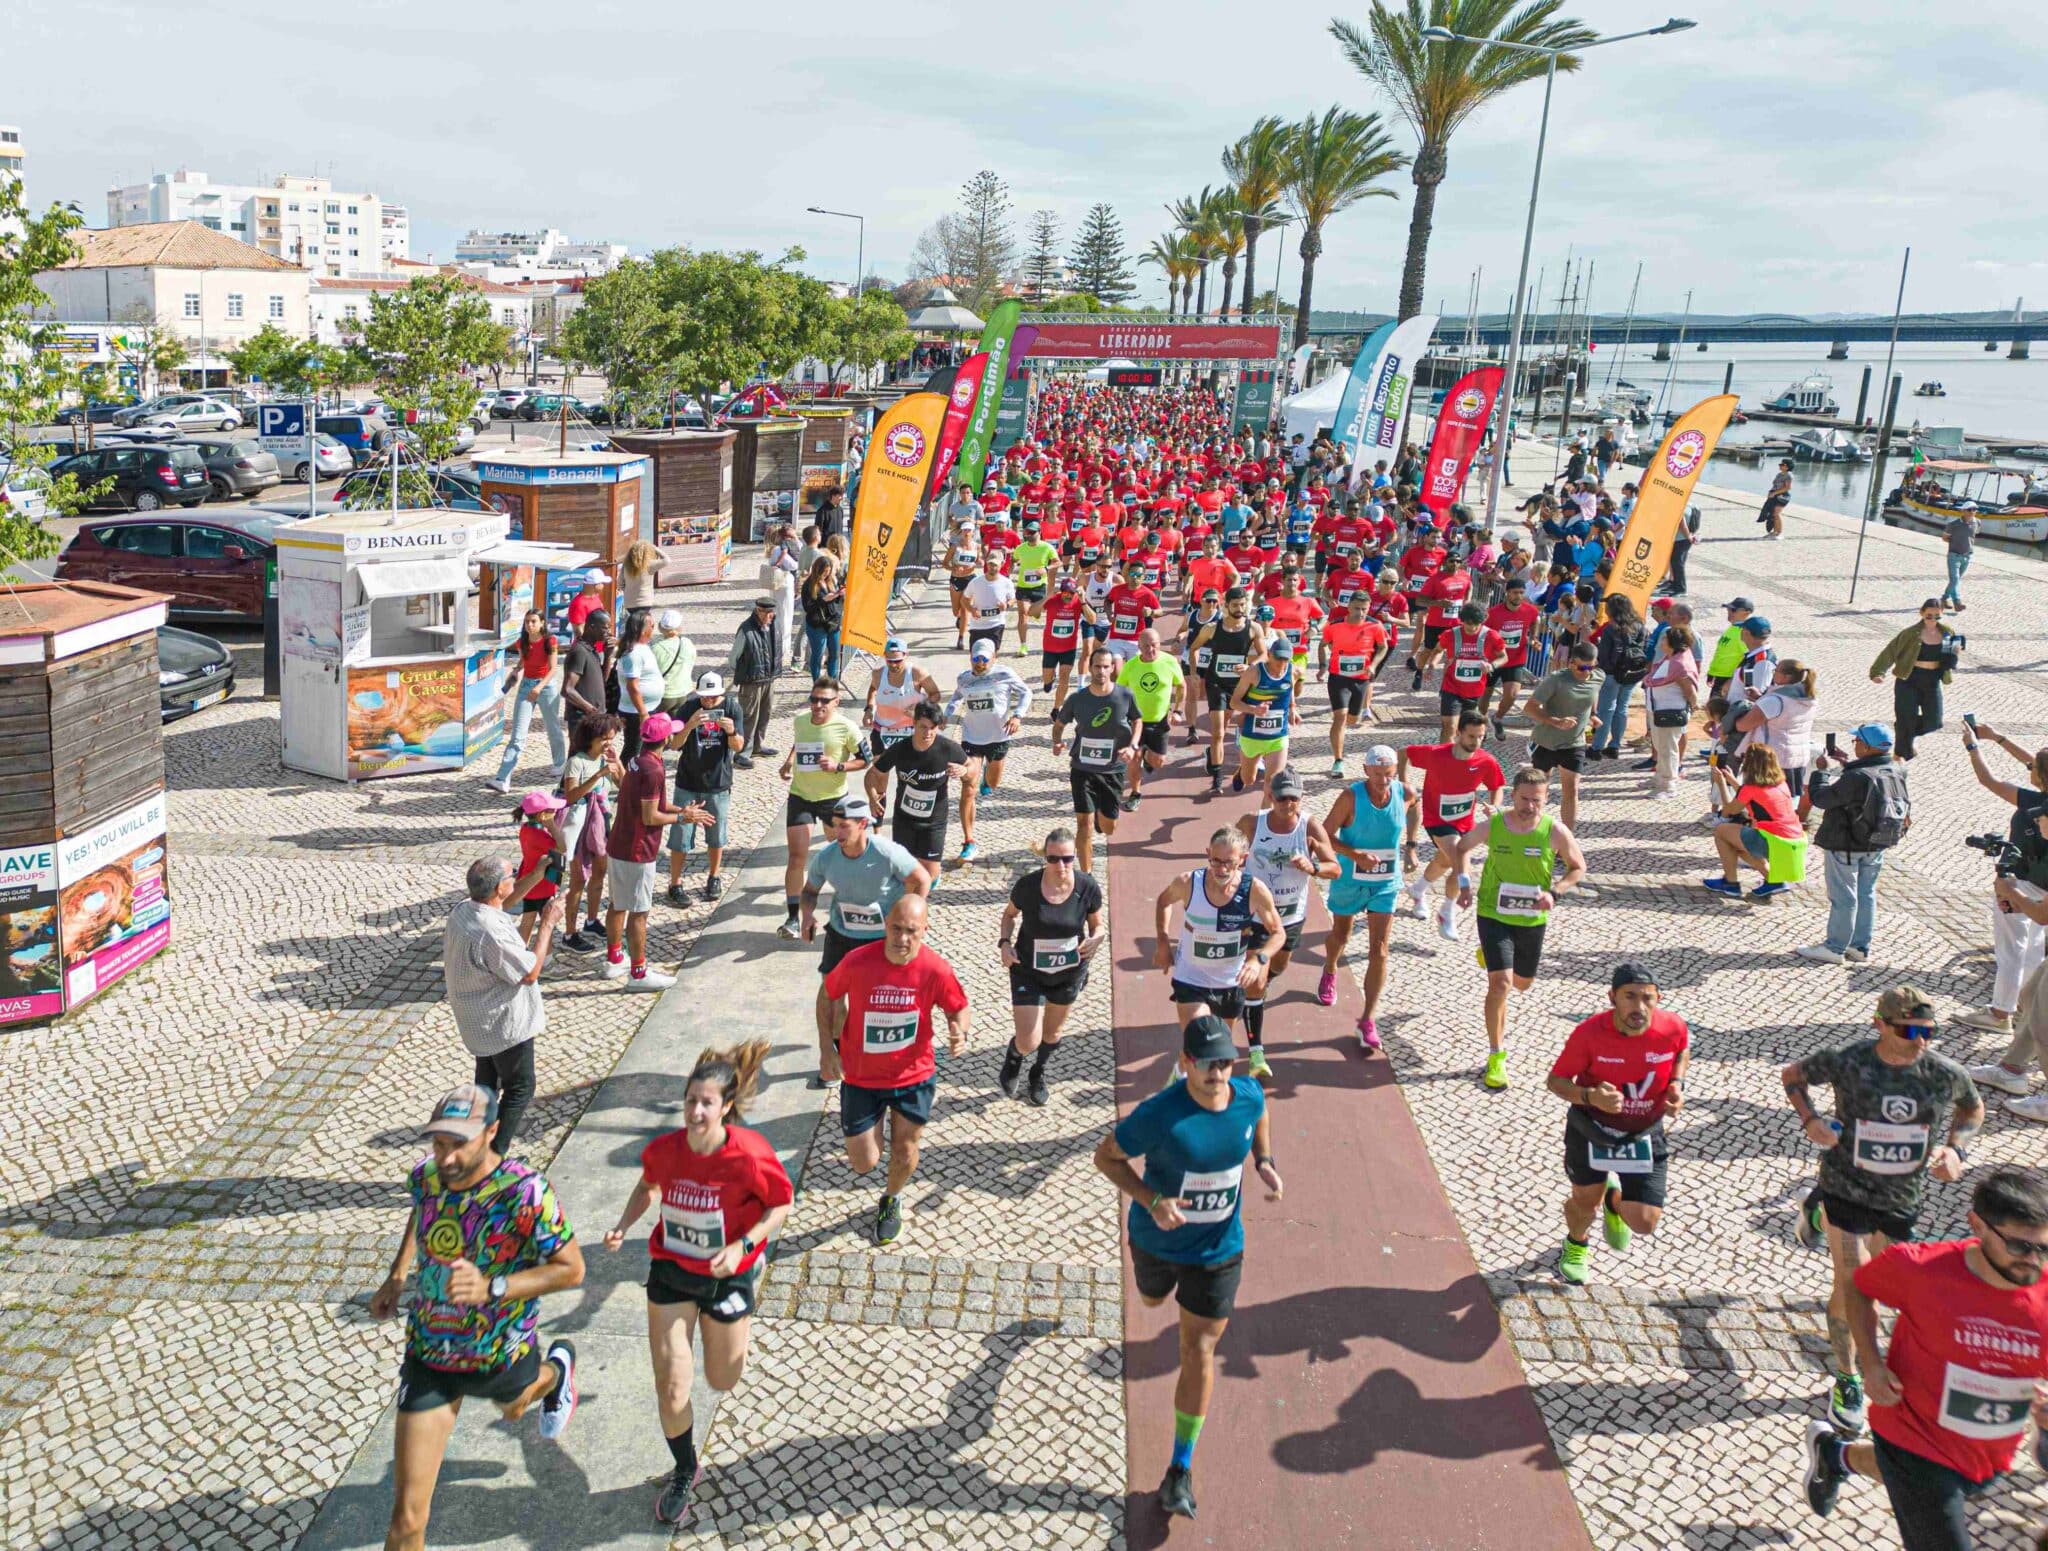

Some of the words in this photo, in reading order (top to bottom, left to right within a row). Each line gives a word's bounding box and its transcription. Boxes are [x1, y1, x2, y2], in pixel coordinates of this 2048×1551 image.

[1100, 334, 1172, 348] LIBERDADE
[974, 338, 1005, 433] Portimão
[1374, 357, 1397, 412] desporto
[1391, 376, 1406, 414] todos!
[264, 408, 284, 433] P
[1366, 413, 1380, 444] mais
[888, 424, 923, 448] BURGER
[1380, 416, 1394, 446] para
[1673, 432, 1704, 457] BURGER
[886, 445, 920, 465] RANCH
[485, 465, 526, 481] Marinha
[549, 466, 603, 481] Benagil
[877, 467, 891, 476] ESTE
[368, 534, 447, 549] BENAGIL
[399, 669, 457, 684] Grutas
[408, 684, 457, 697] Caves
[1260, 718, 1278, 728] 301
[802, 754, 815, 764] 82
[1089, 749, 1103, 758] 62
[909, 799, 928, 810] 109
[65, 844, 91, 865] YES!
[93, 829, 117, 850] YOU
[118, 814, 145, 838] WILL
[147, 807, 160, 824] BE
[1048, 955, 1066, 965] 70
[1207, 947, 1225, 958] 68
[869, 994, 915, 1004] LIBERDADE
[877, 1028, 905, 1042] 161
[1609, 1143, 1637, 1158] 121
[1872, 1145, 1912, 1162] 340
[667, 1189, 720, 1208] LIBERDADE
[1194, 1191, 1229, 1211] 196
[1954, 1328, 2040, 1359] LIBERDADE
[1973, 1402, 2012, 1424] 45
